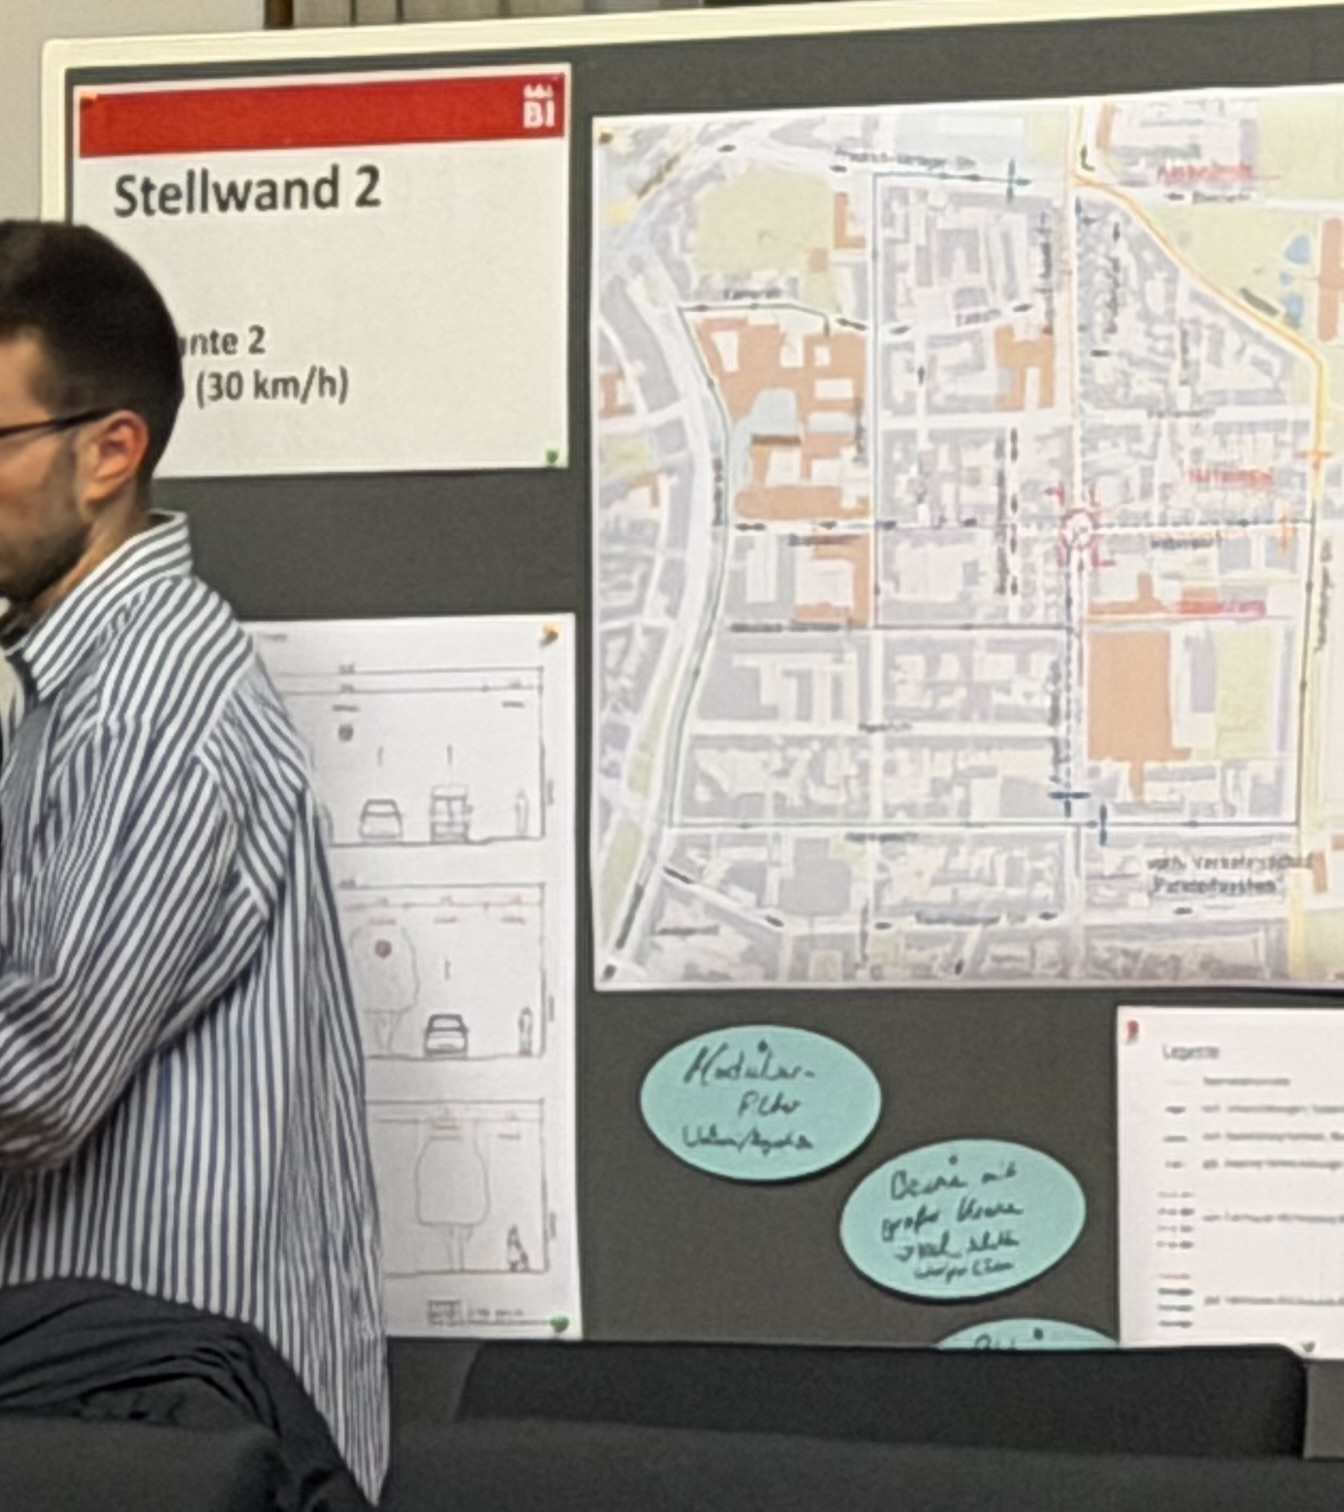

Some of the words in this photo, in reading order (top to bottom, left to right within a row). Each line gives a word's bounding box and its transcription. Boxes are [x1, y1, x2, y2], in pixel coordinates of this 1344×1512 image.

[523, 100, 555, 128] BI
[113, 163, 340, 218] Stellwand
[354, 164, 382, 208] 2
[248, 324, 266, 355] 2
[196, 370, 244, 409] (30
[253, 365, 349, 405] km/h)
